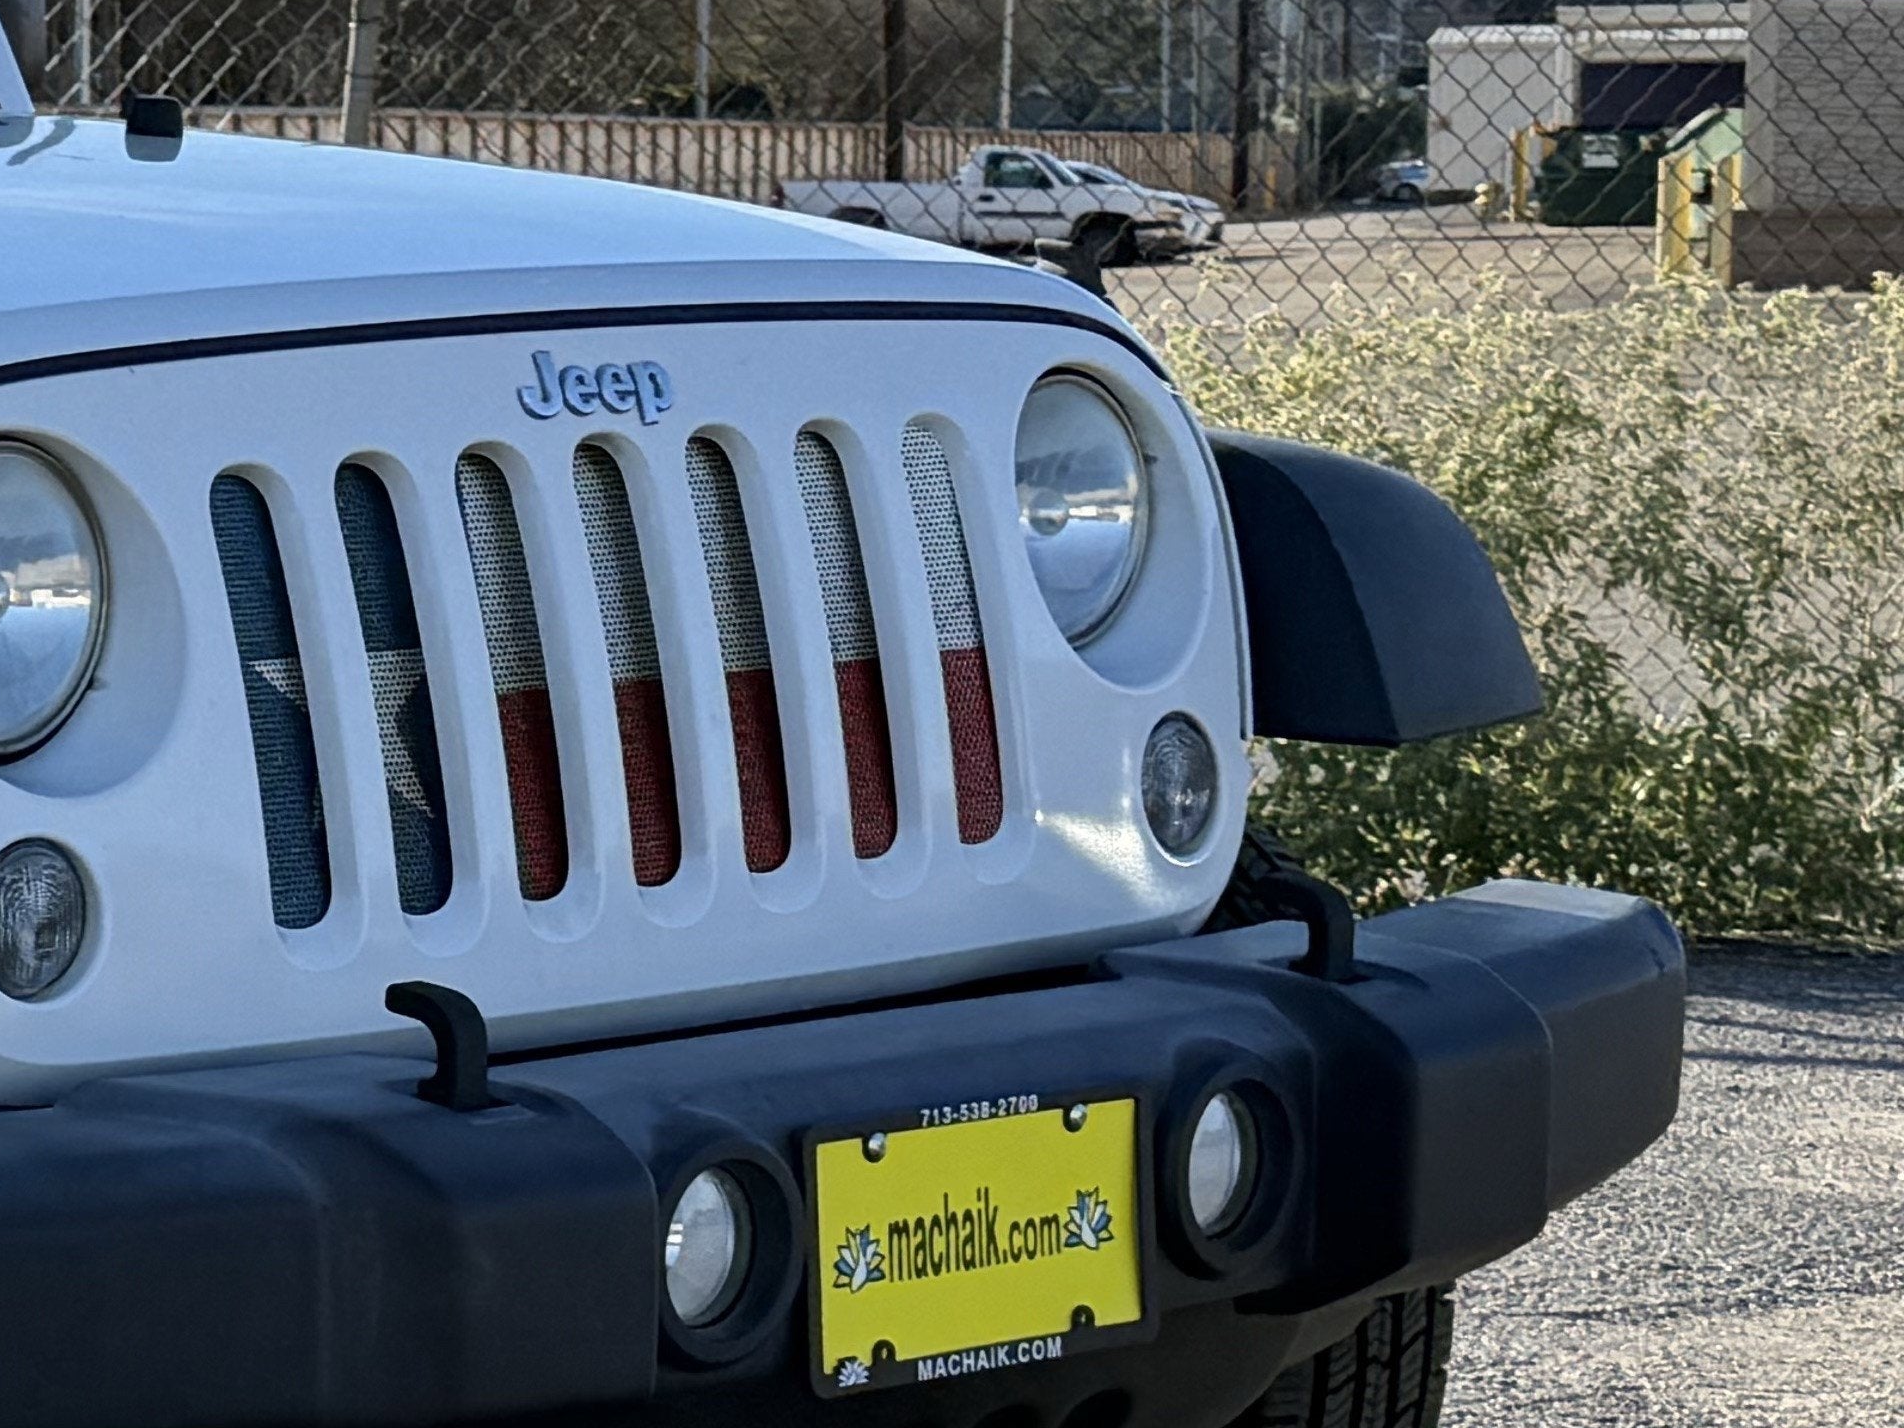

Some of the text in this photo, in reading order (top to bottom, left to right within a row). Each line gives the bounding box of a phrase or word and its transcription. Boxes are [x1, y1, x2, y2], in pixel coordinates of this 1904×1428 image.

[517, 350, 674, 426] Jeep
[888, 1187, 1063, 1283] machaik.com
[917, 1336, 1062, 1381] MACHAIK.COM
